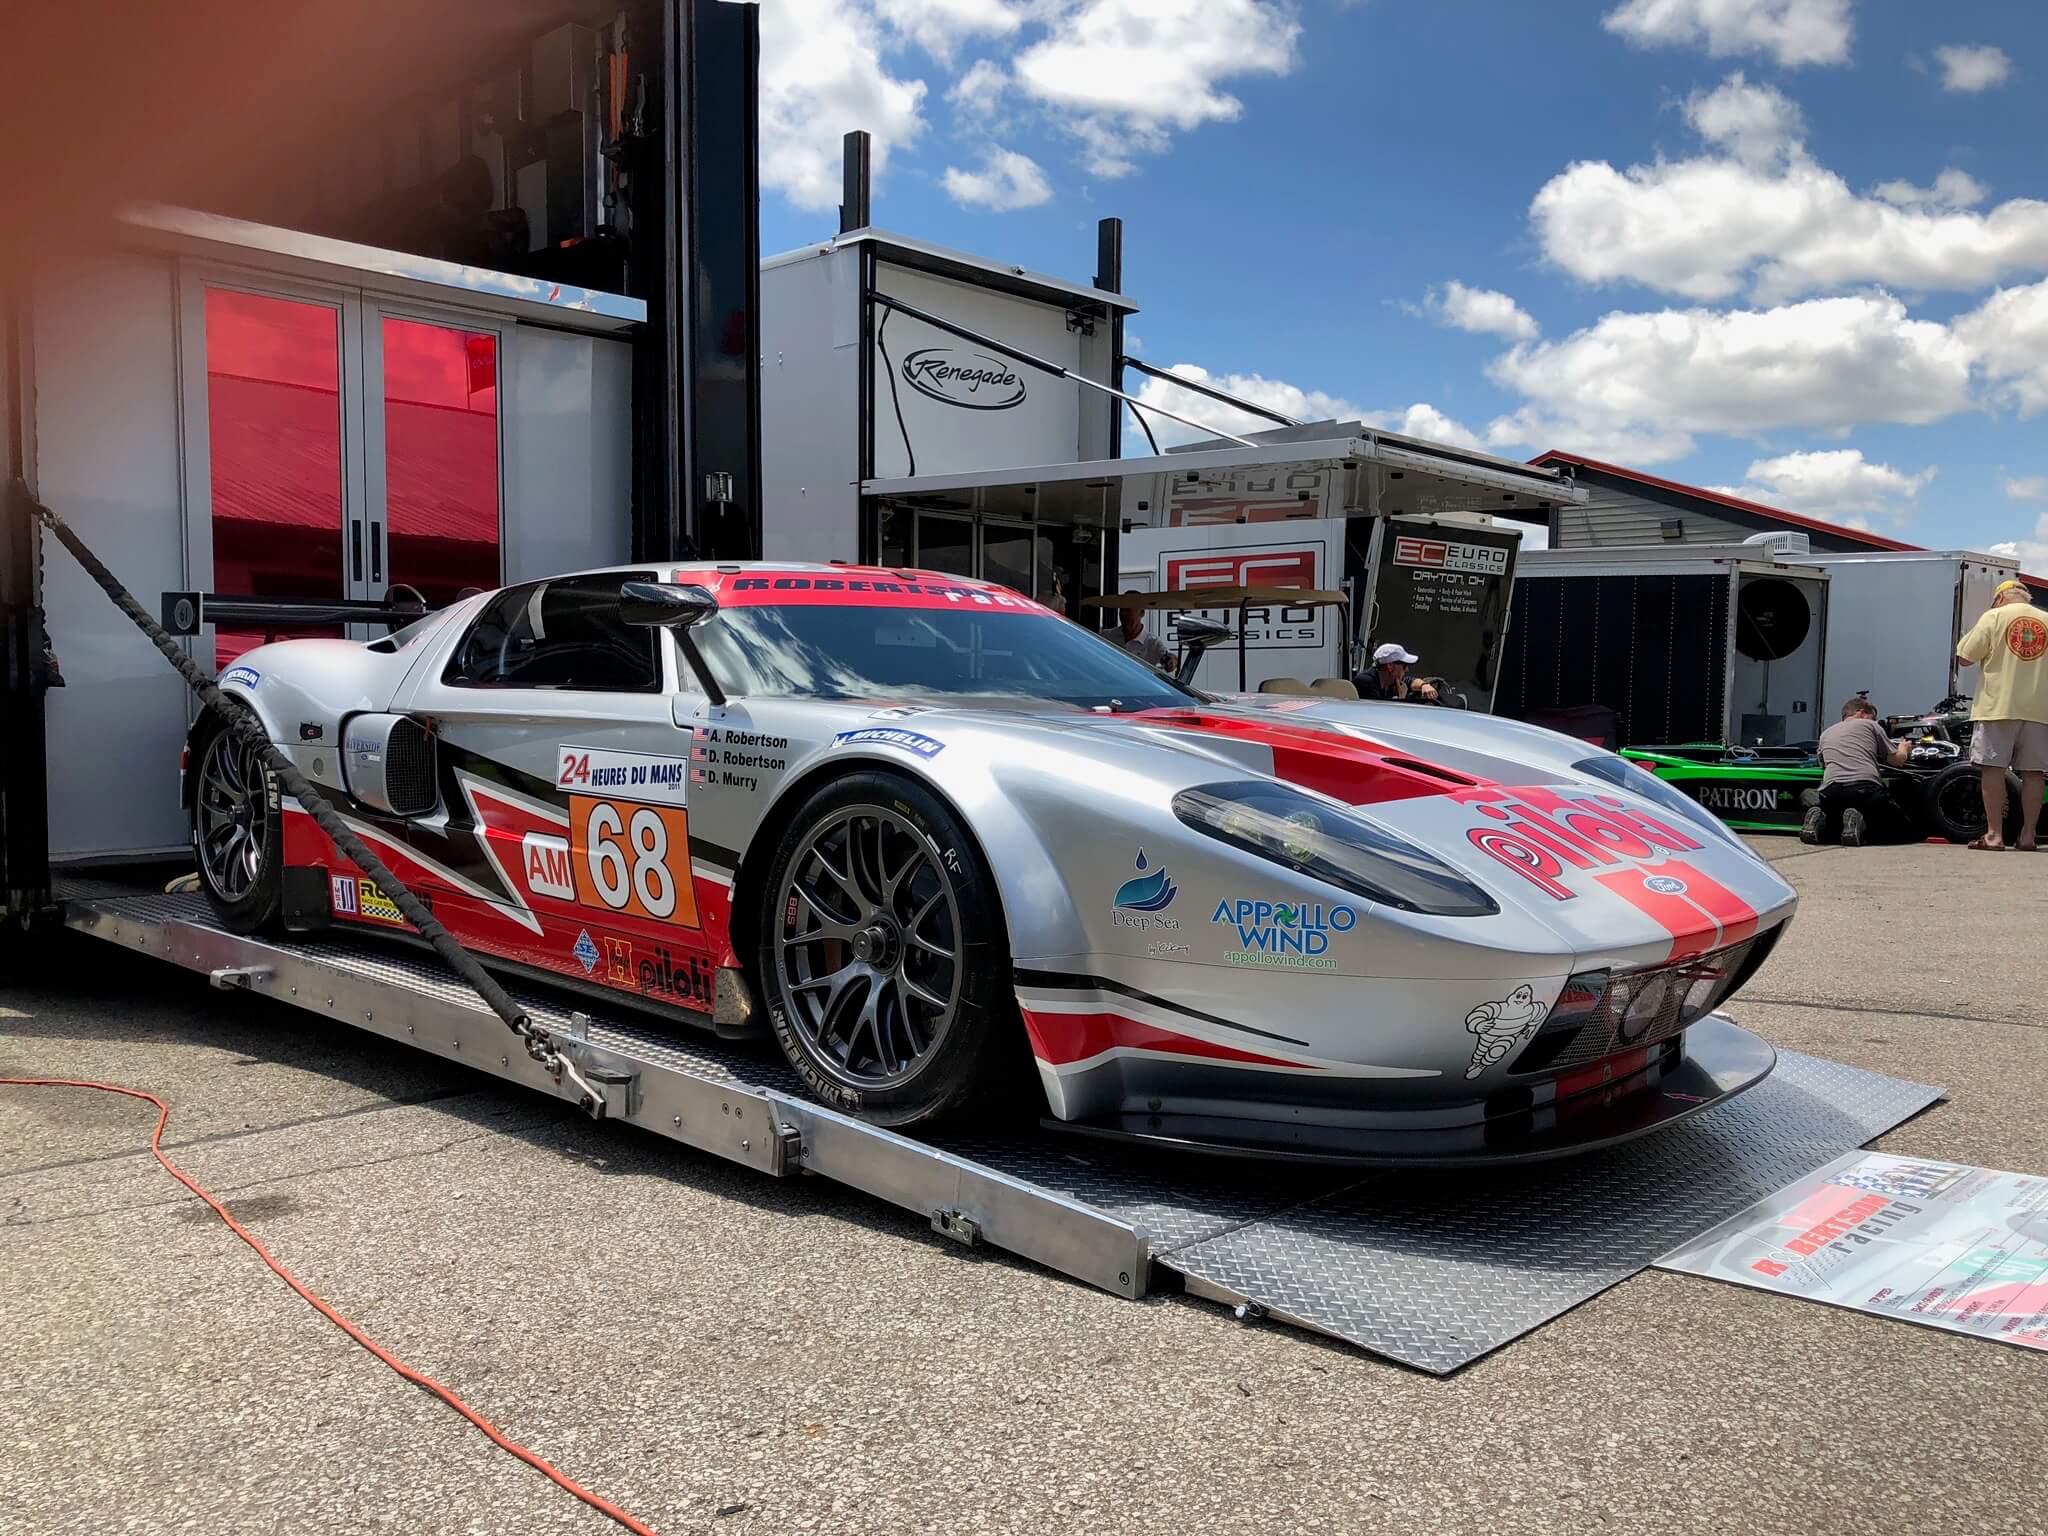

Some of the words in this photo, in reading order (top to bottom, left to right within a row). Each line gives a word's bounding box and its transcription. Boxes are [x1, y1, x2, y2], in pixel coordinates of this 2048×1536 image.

[915, 359, 1016, 392] Renegade
[1397, 540, 1445, 564] EC
[1447, 546, 1505, 562] EURO
[1446, 560, 1503, 572] CLASSICS
[1468, 575, 1485, 586] OH
[709, 728, 722, 743] A.
[725, 729, 788, 749] Robertson
[849, 727, 937, 754] MICHELIN
[560, 753, 590, 784] 24
[592, 766, 627, 787] HEURES
[631, 765, 647, 785] DU
[650, 762, 683, 784] MANS
[708, 750, 720, 764] D.
[723, 751, 786, 770] Robertson
[668, 783, 681, 791] 2011
[708, 770, 719, 784] D.
[722, 770, 758, 791] Murry
[1699, 786, 1778, 810] PATRON
[586, 801, 677, 919] 68
[1465, 793, 1707, 901] piloti
[529, 845, 570, 889] AM
[944, 847, 962, 875] RF
[787, 896, 798, 925] BBS
[1112, 911, 1150, 931] Deep
[1154, 912, 1181, 930] Sea
[1210, 896, 1358, 933] APPOLLO
[1237, 924, 1329, 956] WIND
[1223, 950, 1338, 970] appollowind.com
[639, 946, 712, 1007] piloti
[772, 1010, 841, 1105] MICHELIN
[1829, 1200, 1923, 1256] racing
